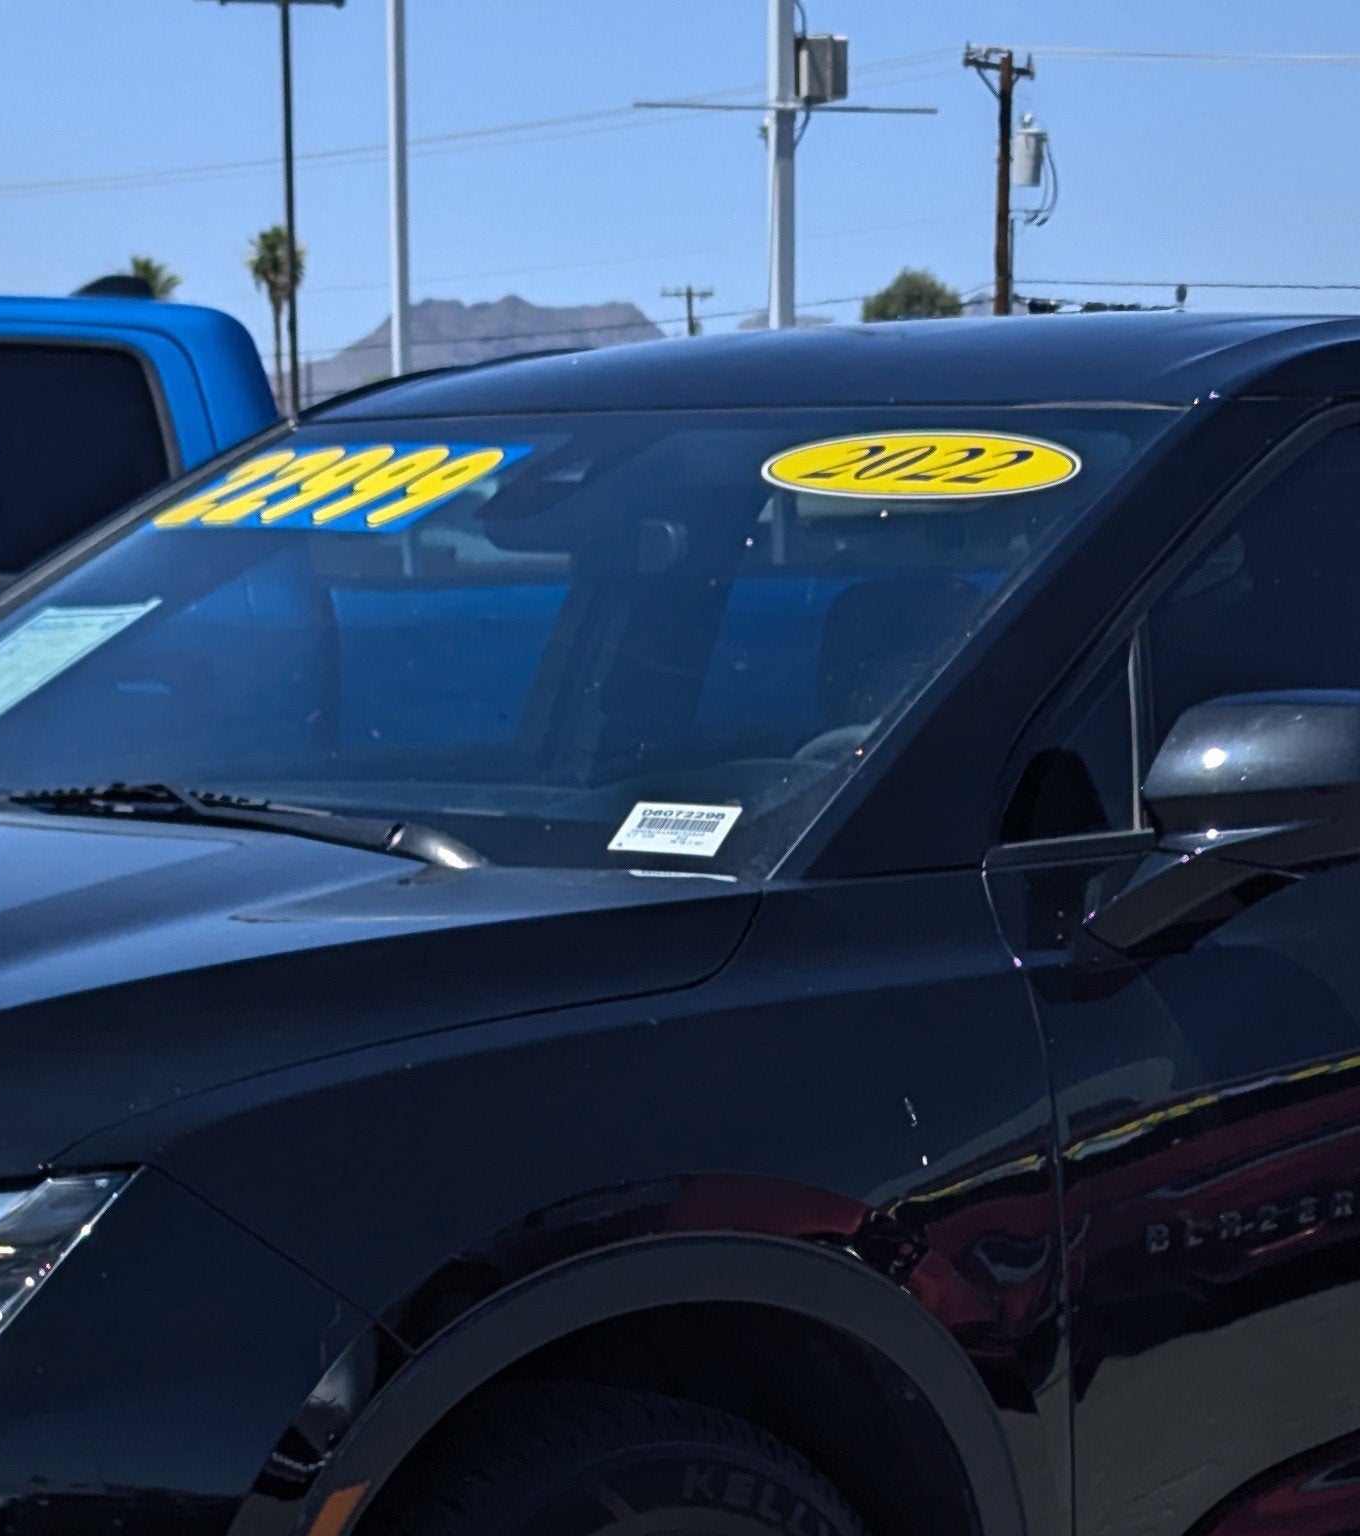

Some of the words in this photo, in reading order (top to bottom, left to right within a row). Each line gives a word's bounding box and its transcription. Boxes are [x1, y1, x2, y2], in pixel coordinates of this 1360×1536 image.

[153, 445, 504, 529] 22999
[797, 445, 1034, 484] 2022
[1146, 1189, 1356, 1254] BLAZER
